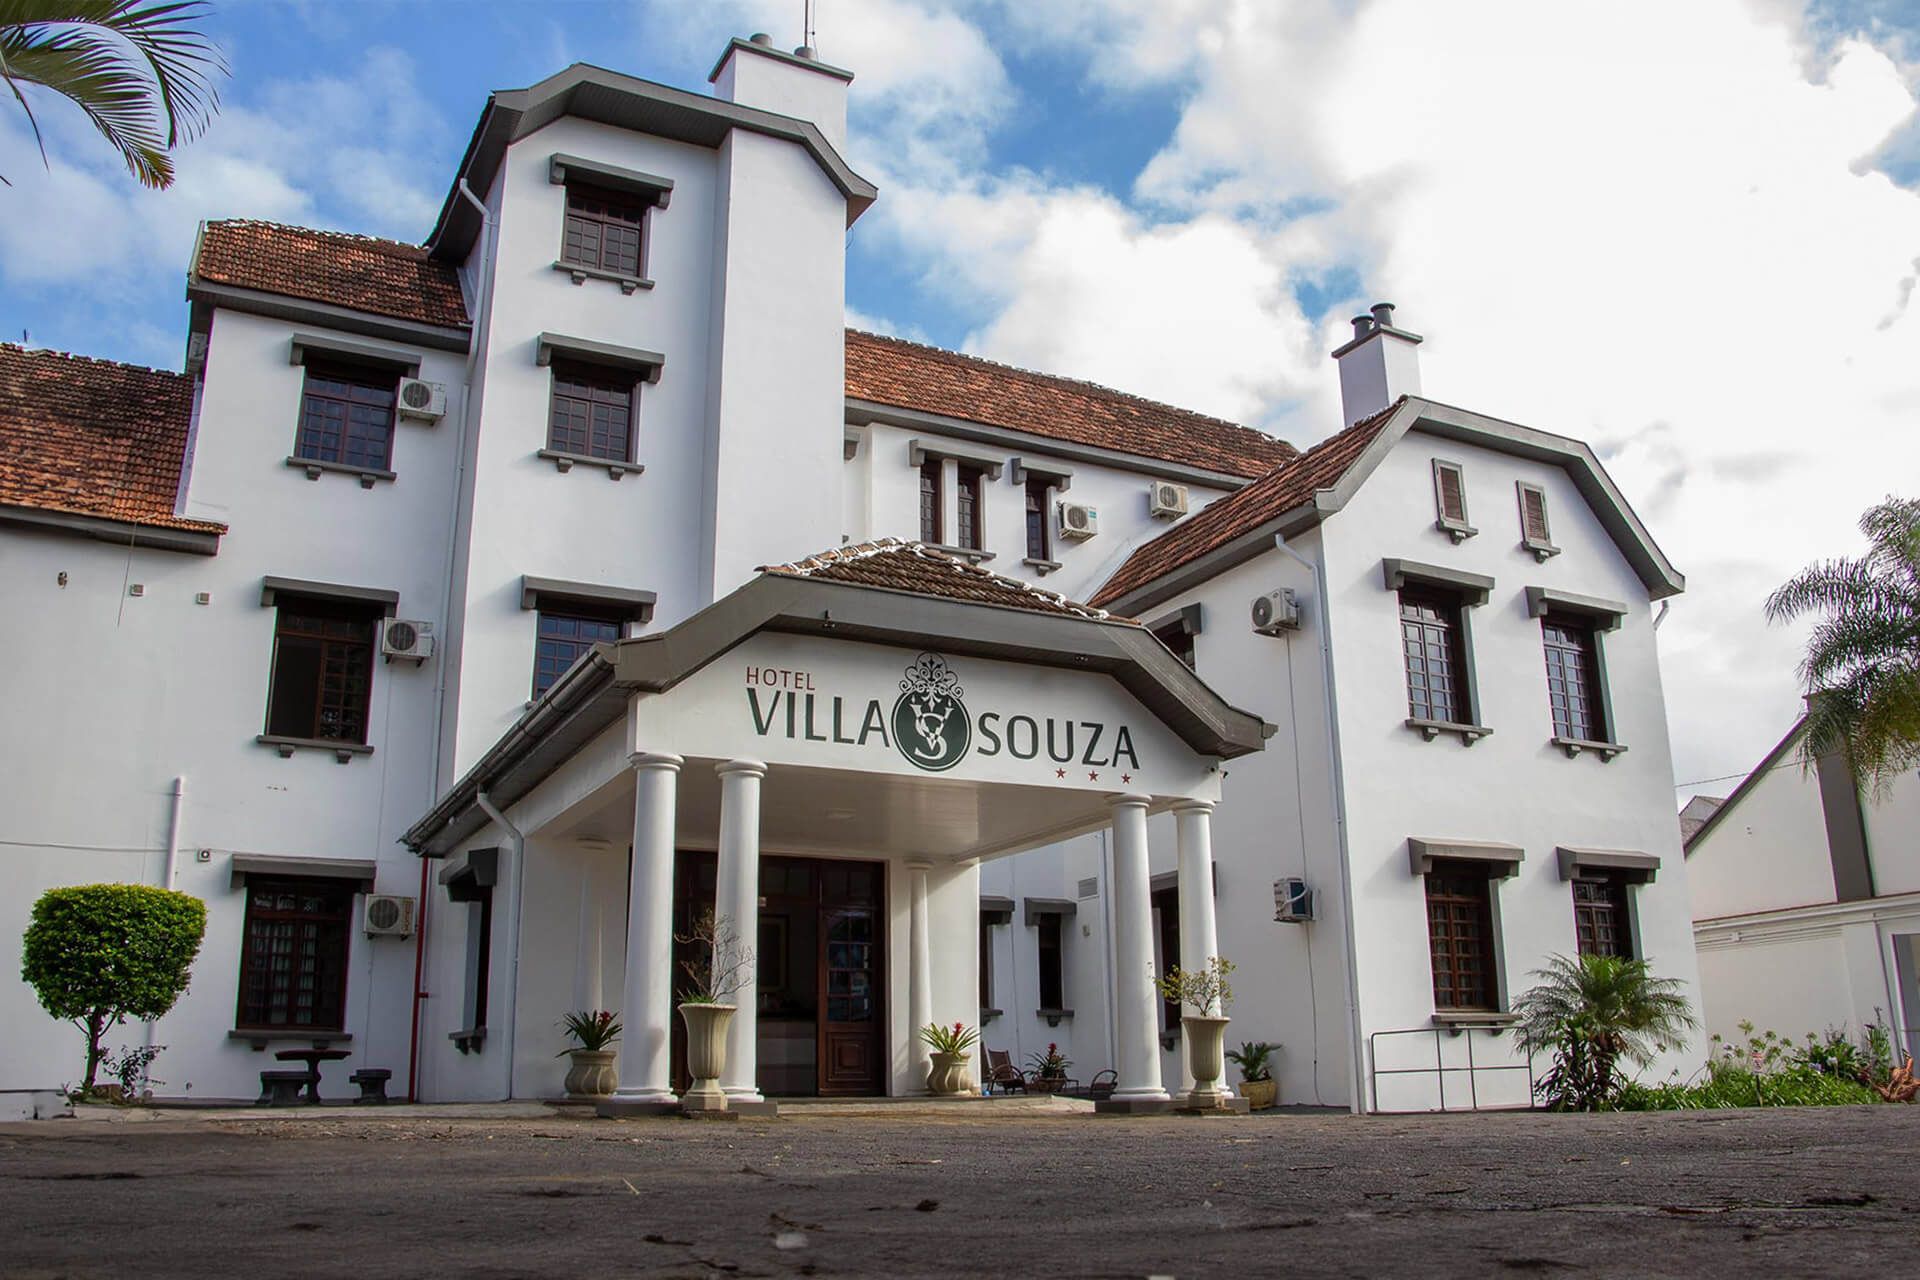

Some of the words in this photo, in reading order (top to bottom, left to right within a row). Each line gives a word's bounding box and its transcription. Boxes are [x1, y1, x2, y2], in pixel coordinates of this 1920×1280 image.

[746, 666, 815, 691] HOTEL
[746, 687, 890, 748] VILLA
[976, 712, 1140, 770] SOUZA
